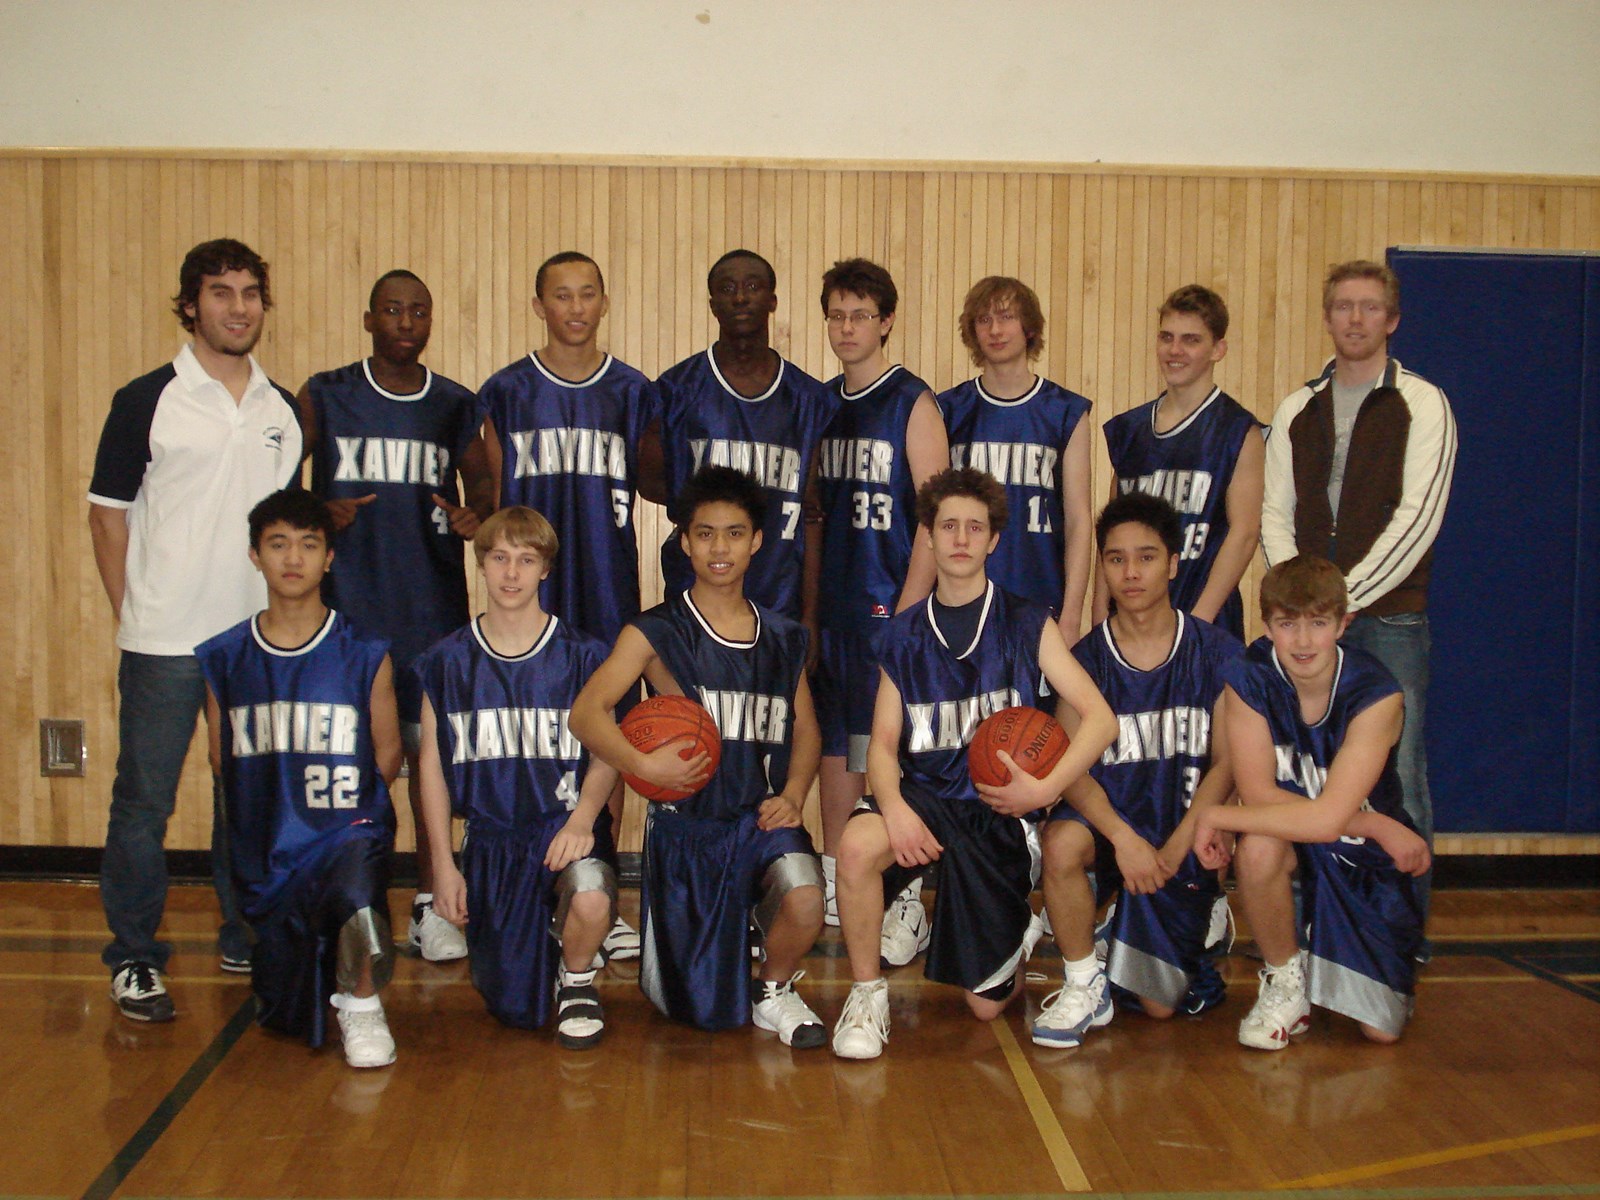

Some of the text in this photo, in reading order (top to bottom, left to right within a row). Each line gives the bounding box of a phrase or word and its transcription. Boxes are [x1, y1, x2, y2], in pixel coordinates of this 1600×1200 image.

[508, 426, 627, 480] XAVIER
[818, 437, 894, 485] AVIER
[611, 488, 630, 529] 5
[781, 500, 802, 540] 7
[852, 491, 894, 531] 33
[228, 701, 359, 758] XAVIER
[447, 707, 582, 764] XAVIER
[694, 685, 788, 745] AVIER
[304, 764, 360, 809] 22
[554, 770, 580, 812] 4
